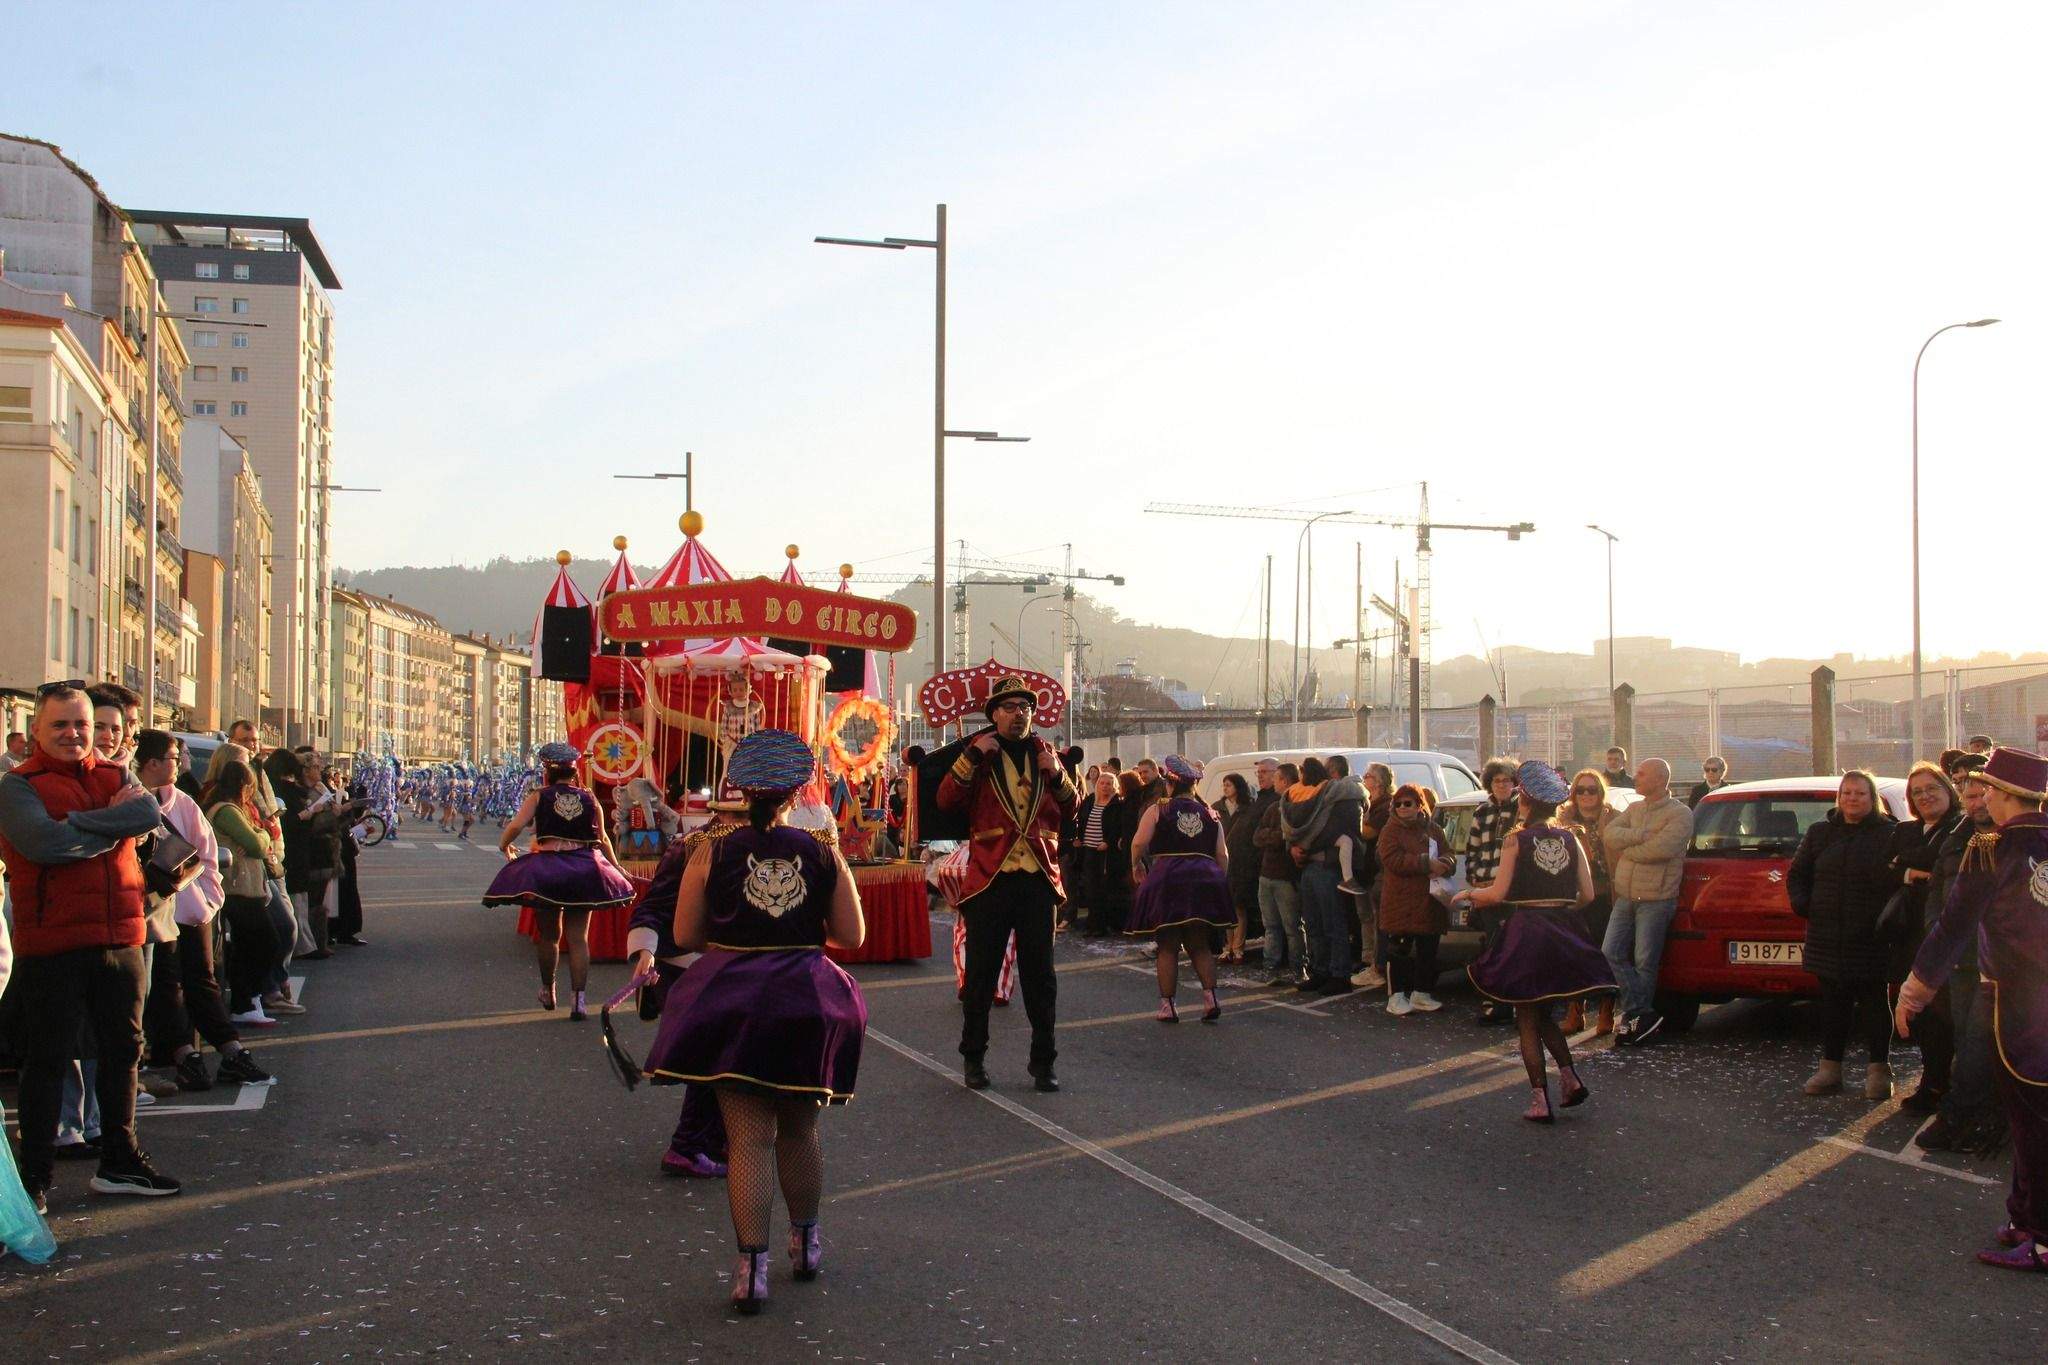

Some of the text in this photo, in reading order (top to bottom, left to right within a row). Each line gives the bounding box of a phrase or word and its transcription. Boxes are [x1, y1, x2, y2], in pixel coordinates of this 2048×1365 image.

[617, 598, 898, 639] A MAXIA DO CIRCO
[933, 675, 1053, 710] CIO
[1741, 944, 1781, 959] 9187
